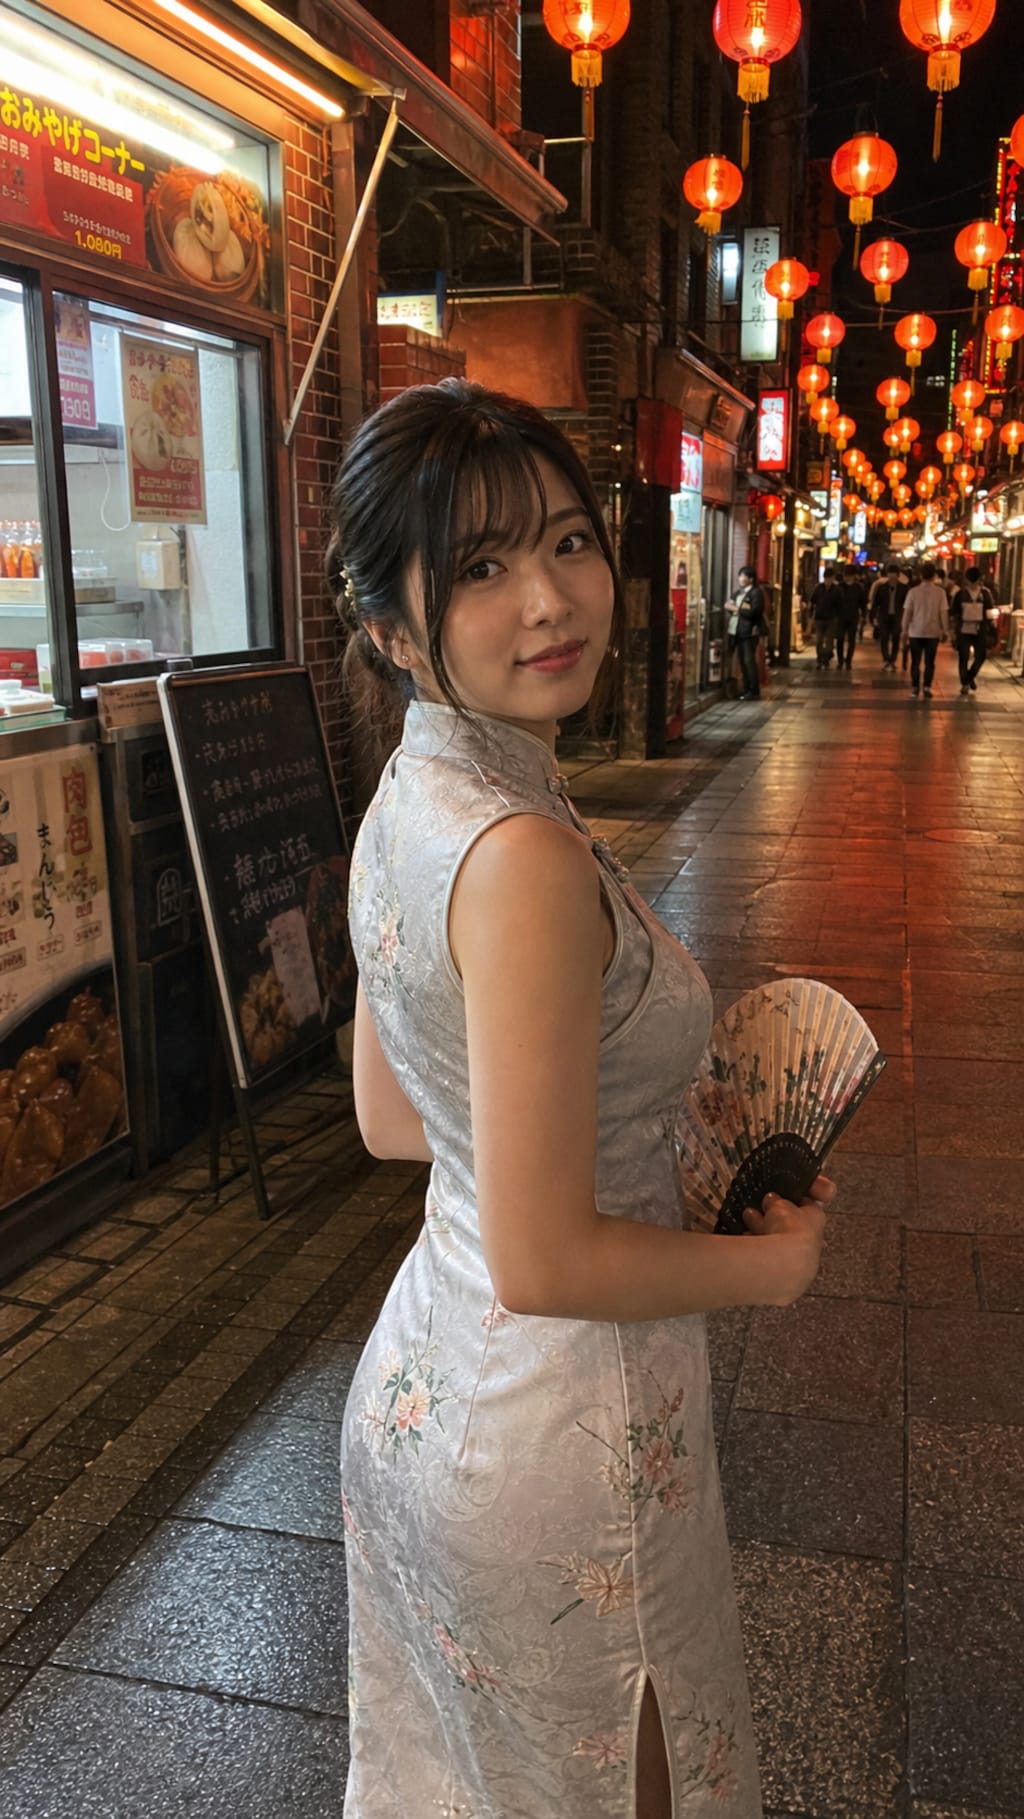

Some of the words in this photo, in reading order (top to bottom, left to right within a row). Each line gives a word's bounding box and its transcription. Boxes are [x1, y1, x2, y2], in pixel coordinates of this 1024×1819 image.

[0, 86, 145, 175] おみやげコーナー
